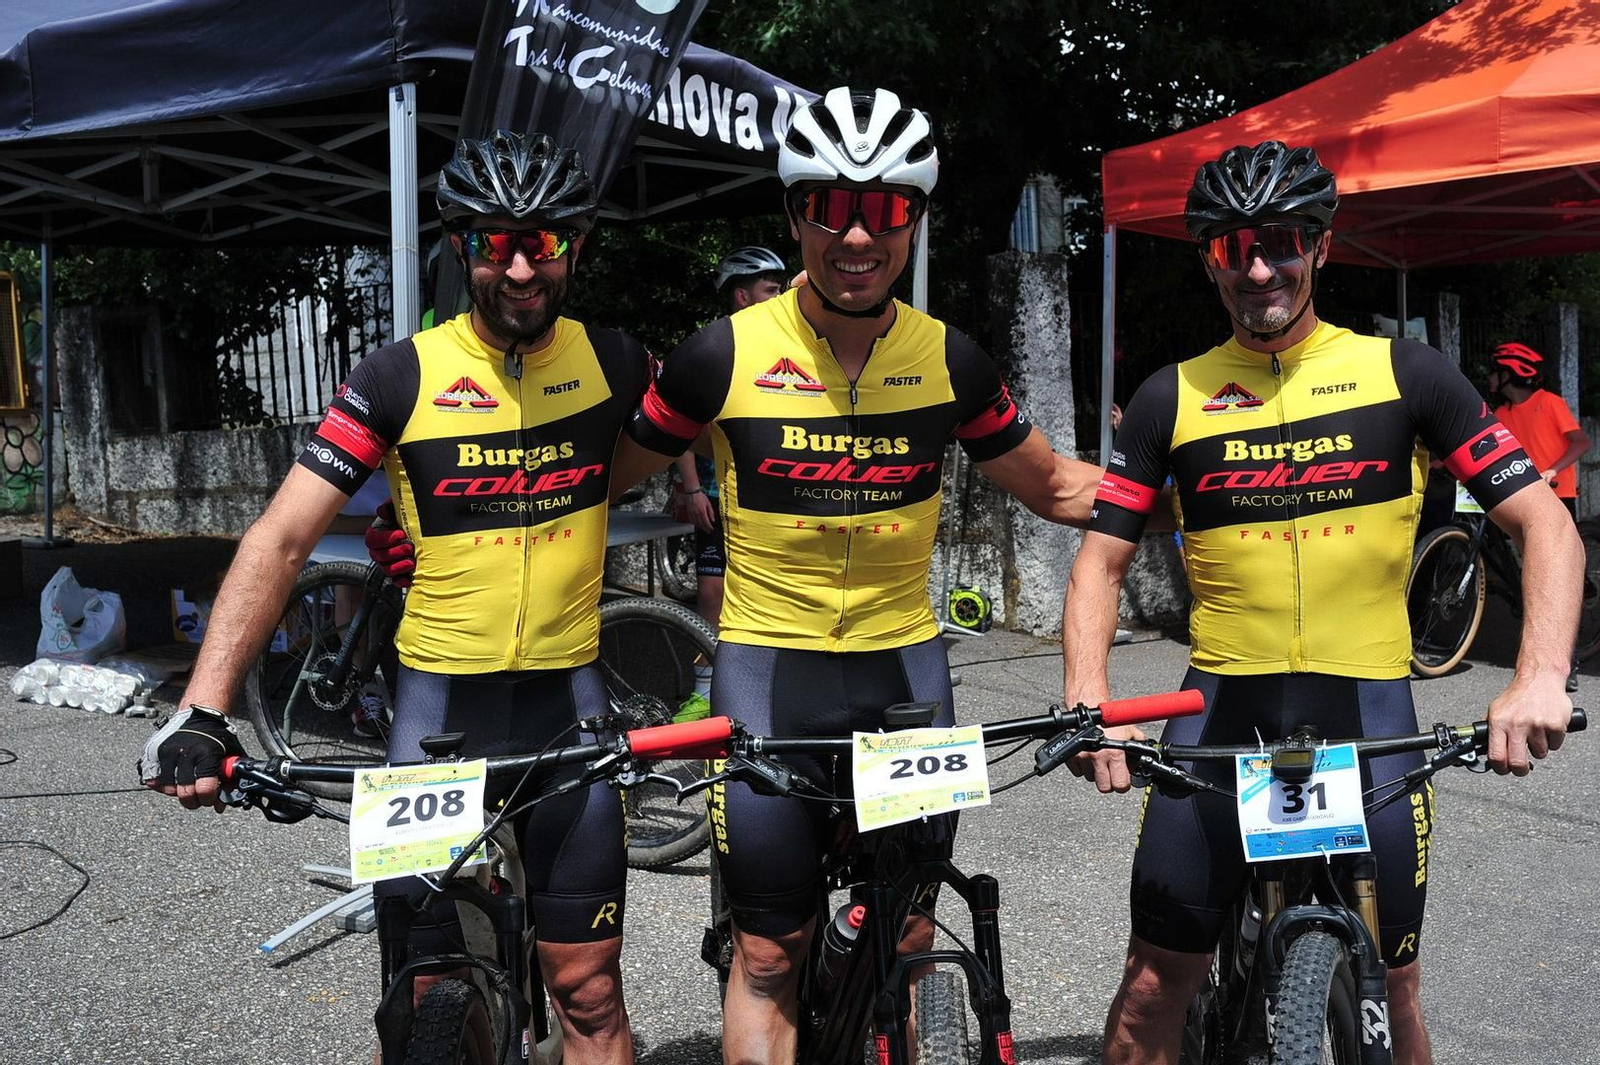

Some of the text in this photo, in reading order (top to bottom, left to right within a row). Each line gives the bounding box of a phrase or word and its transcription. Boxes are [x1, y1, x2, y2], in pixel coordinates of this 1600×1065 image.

[542, 379, 580, 396] FASTER
[882, 374, 922, 387] FASTER
[1310, 382, 1357, 396] FASTER
[780, 425, 909, 459] Burgas
[1223, 432, 1353, 463] Burgas
[306, 441, 358, 479] CROWN
[456, 440, 574, 471] Burgas
[470, 494, 572, 514] FACTORY TEAM
[793, 486, 903, 502] FACTORY TEAM
[1231, 487, 1353, 508] FACTORY TEAM
[474, 528, 573, 546] FASTER
[796, 520, 901, 535] FASTER
[1239, 524, 1356, 541] FASTER
[889, 754, 969, 779] 208
[386, 789, 465, 828] 208
[1281, 782, 1327, 814] 31
[1410, 792, 1429, 888] Burgas
